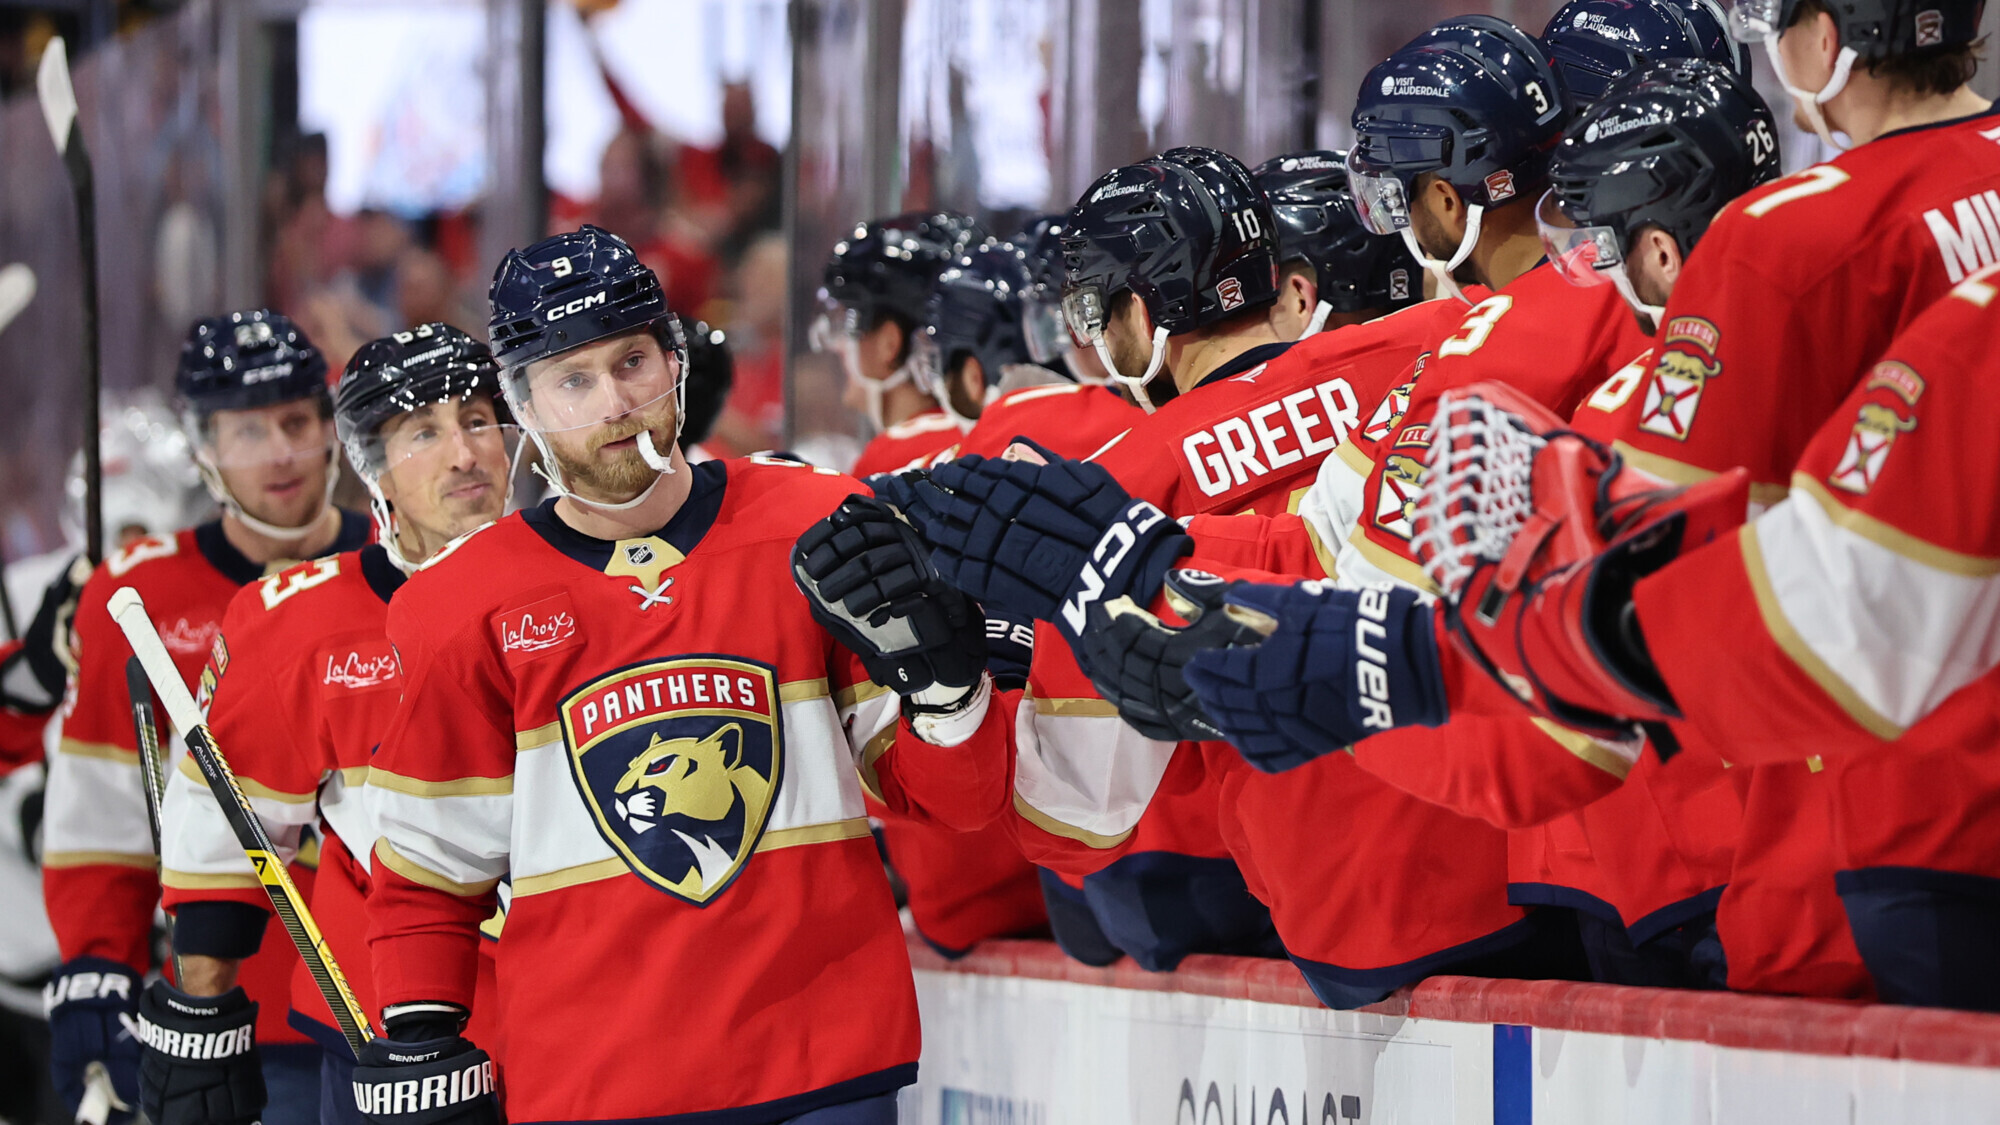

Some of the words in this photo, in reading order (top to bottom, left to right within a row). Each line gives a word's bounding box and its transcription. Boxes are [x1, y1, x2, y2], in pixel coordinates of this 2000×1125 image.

[1583, 20, 1636, 41] LAUDERDALE
[1588, 13, 1607, 24] VISIT
[1394, 85, 1450, 98] LAUDERDALE
[1395, 77, 1415, 87] VISIT
[1525, 81, 1549, 115] 3
[1599, 115, 1621, 129] VISIT
[1599, 113, 1660, 139] LAUDERDALE
[1746, 120, 1774, 165] 26
[1100, 184, 1145, 200] LAUDERDALE
[1102, 182, 1119, 191] VISIT
[1231, 208, 1261, 242] 10
[551, 256, 573, 278] 9
[547, 291, 606, 322] CCM
[1438, 295, 1514, 359] 3
[402, 345, 454, 368] WARRIOR
[1182, 377, 1360, 497] GREER
[1061, 501, 1167, 637] CCM
[581, 673, 756, 735] PANTHERS
[137, 1012, 252, 1060] WARRIOR
[388, 1051, 440, 1063] BENNETT
[352, 1060, 495, 1115] WARRIOR
